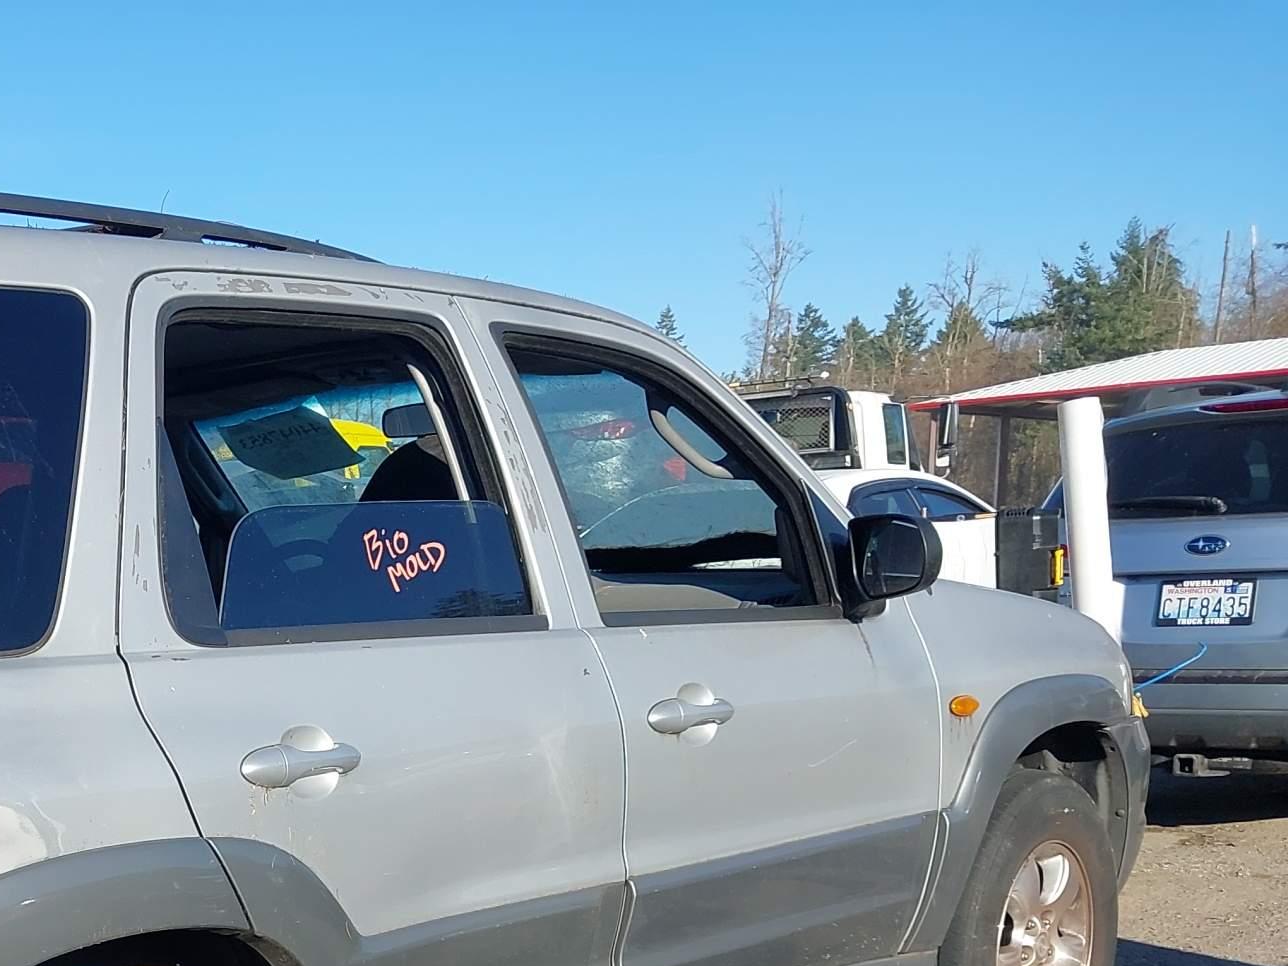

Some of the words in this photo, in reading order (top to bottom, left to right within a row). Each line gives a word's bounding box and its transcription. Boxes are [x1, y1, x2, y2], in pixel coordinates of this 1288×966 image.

[387, 542, 445, 592] MOLD
[1183, 579, 1233, 587] OVERLAND
[1161, 596, 1249, 618] CTF8435
